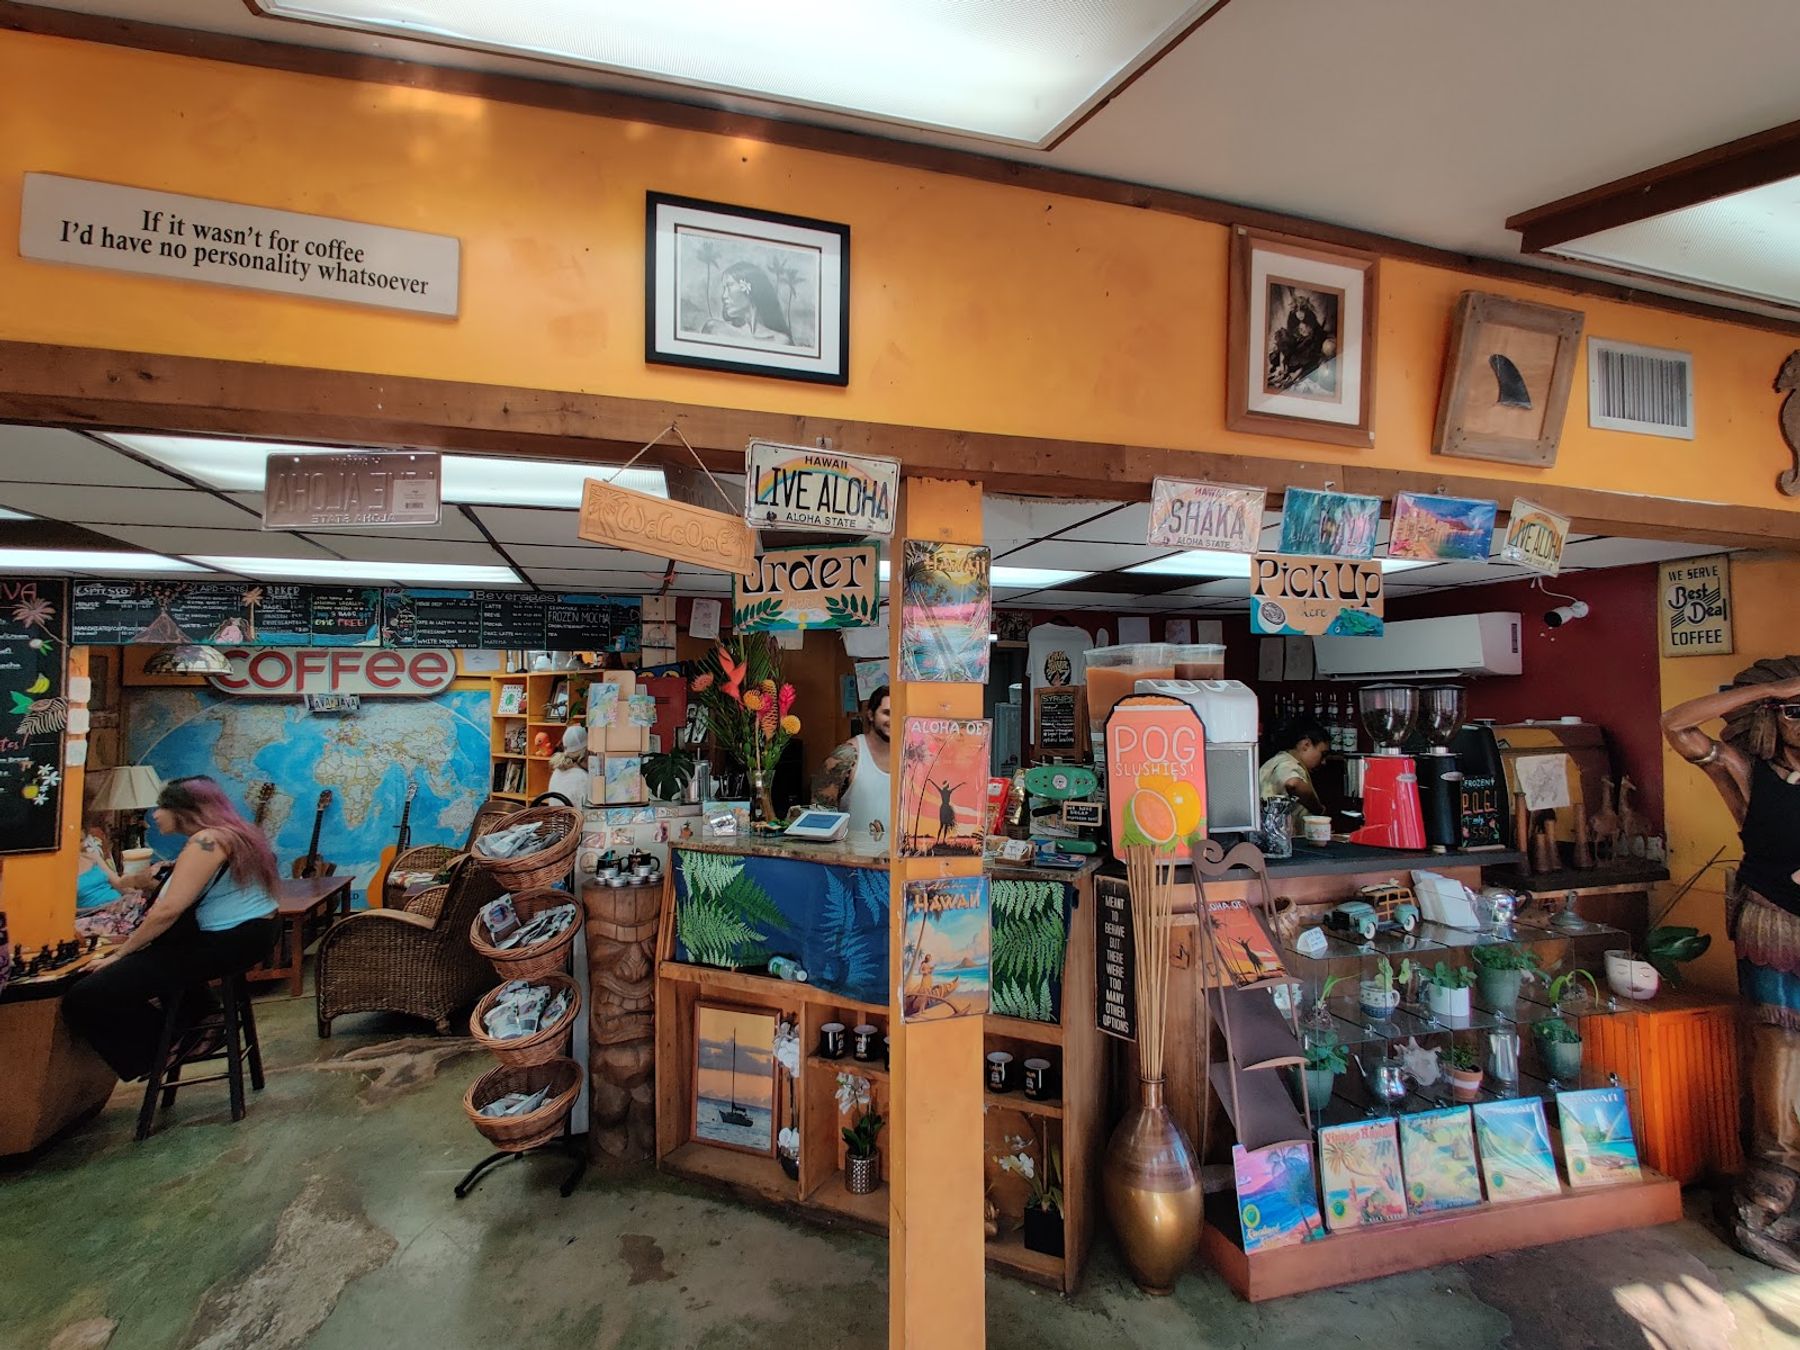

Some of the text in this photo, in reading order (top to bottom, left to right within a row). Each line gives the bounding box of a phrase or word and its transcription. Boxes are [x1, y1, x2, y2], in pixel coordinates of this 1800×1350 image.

[142, 209, 365, 264] If it wasn't for coffee
[60, 219, 429, 296] I'd have no personality whatsoever
[804, 454, 848, 470] HAWAII
[754, 464, 890, 520] LIVE ALOHA
[785, 511, 857, 529] ALOHA STATE
[1168, 498, 1246, 541] SHAKA
[1176, 537, 1231, 549] ALOHA STATE
[1669, 565, 1718, 581] WE SERVE
[1254, 558, 1382, 608] Pick Up
[475, 590, 556, 603] Beverages
[1667, 582, 1708, 610] Best
[1687, 598, 1728, 624] Deal
[1670, 629, 1722, 646] COFFEE
[911, 719, 960, 735] ALOHA
[1113, 725, 1198, 764] POG
[1114, 760, 1195, 778] SLUSHIES!
[1111, 910, 1119, 922] TO
[1105, 962, 1125, 978] WERE
[1109, 976, 1122, 991] TOO
[1105, 989, 1125, 1005] MANY
[1105, 1002, 1126, 1019] OTHER
[1102, 1014, 1130, 1034] OPTIONS
